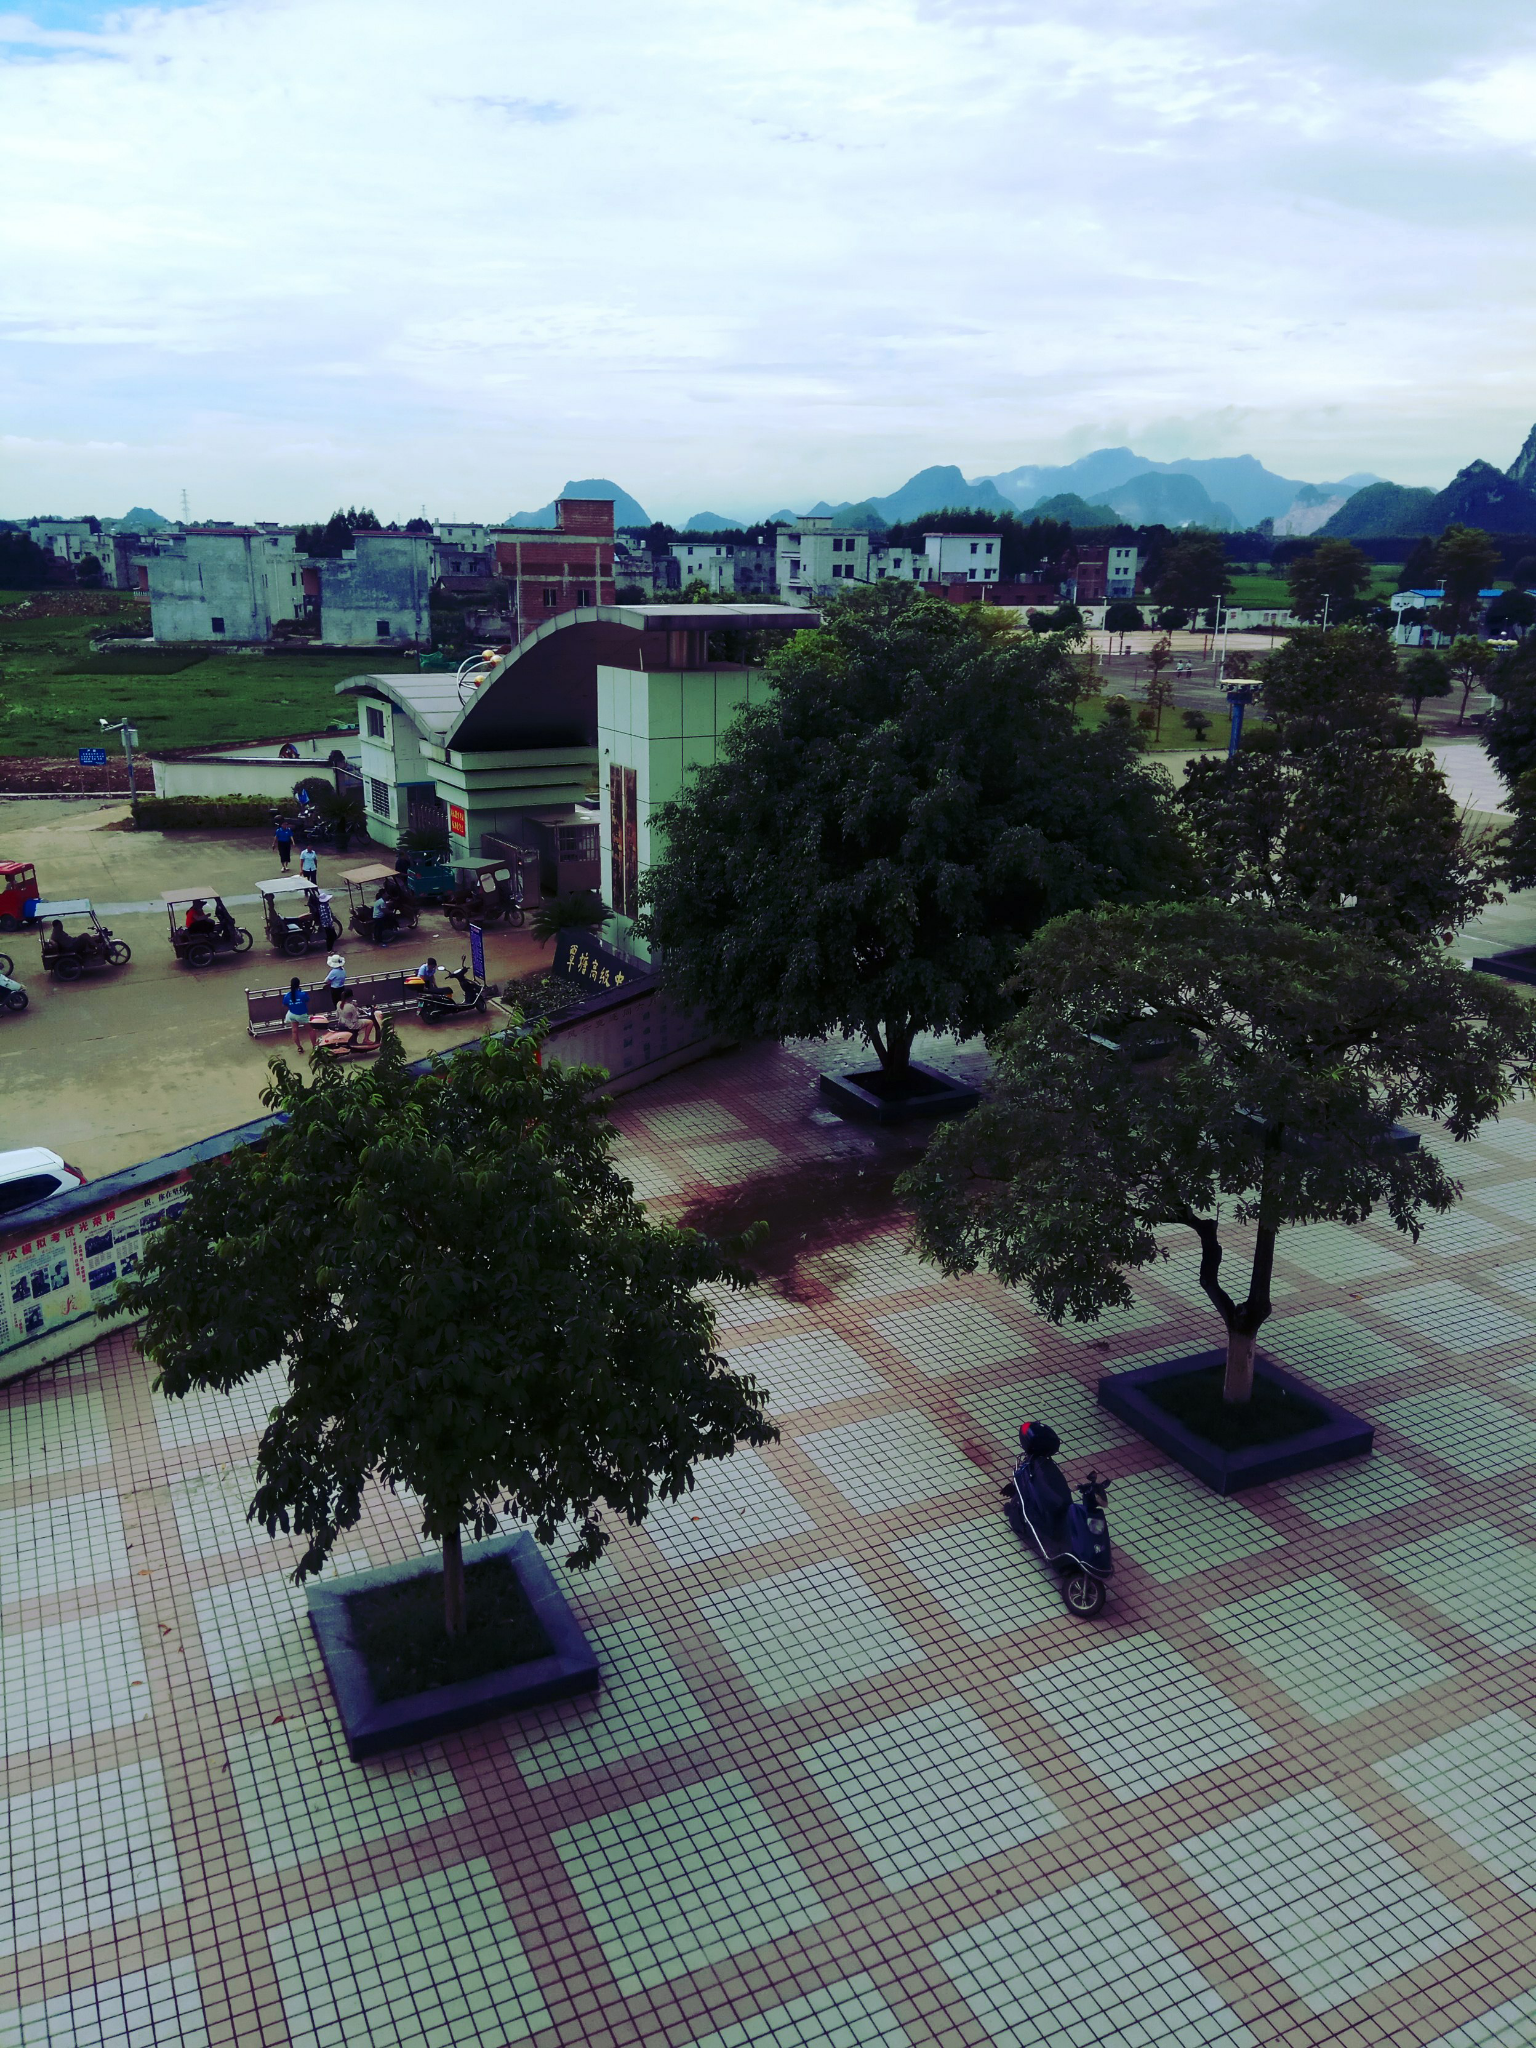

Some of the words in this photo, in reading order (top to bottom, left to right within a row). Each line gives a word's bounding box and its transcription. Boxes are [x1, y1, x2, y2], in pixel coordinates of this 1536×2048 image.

[0, 1211, 116, 1264] 次模拟考试光荣榜
